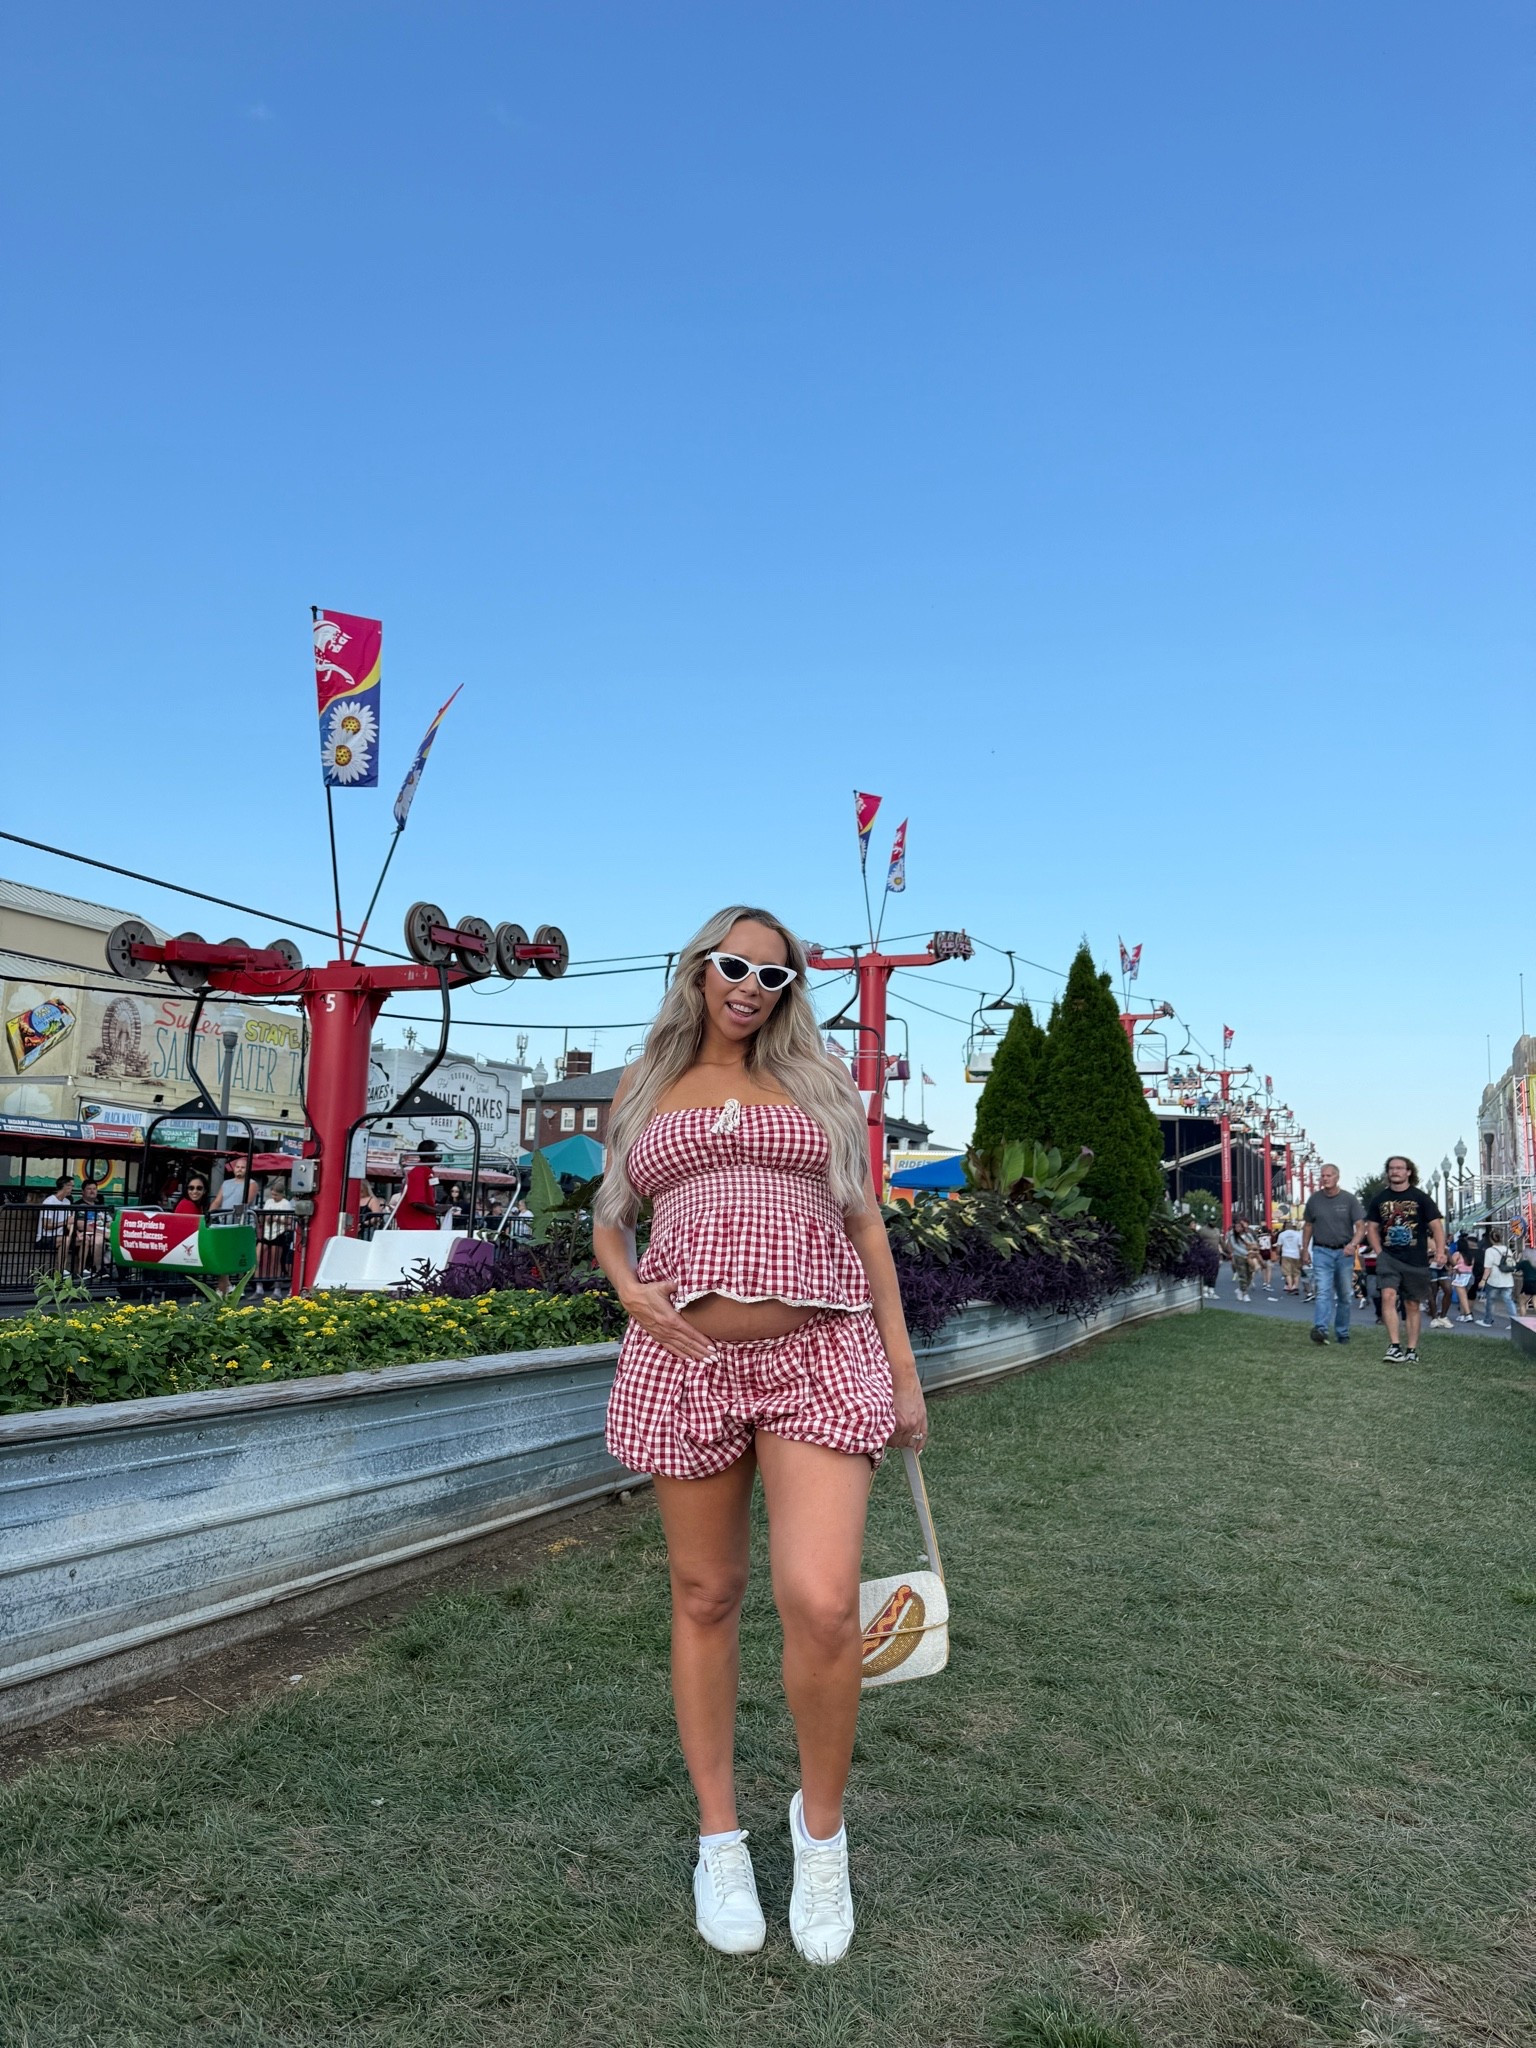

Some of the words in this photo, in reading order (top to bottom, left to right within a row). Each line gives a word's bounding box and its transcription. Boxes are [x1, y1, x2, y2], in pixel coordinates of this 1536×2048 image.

[325, 993, 336, 1013] 5
[245, 1020, 301, 1049] STATE
[153, 1027, 205, 1082] SALT
[467, 1096, 503, 1120] CAKES
[122, 1230, 142, 1239] Student
[123, 1219, 137, 1228] From
[137, 1220, 159, 1230] Skyrides
[159, 1221, 165, 1230] to
[123, 1240, 139, 1249] That's
[139, 1241, 150, 1249] How
[150, 1242, 158, 1250] We
[158, 1242, 169, 1252] Fly!
